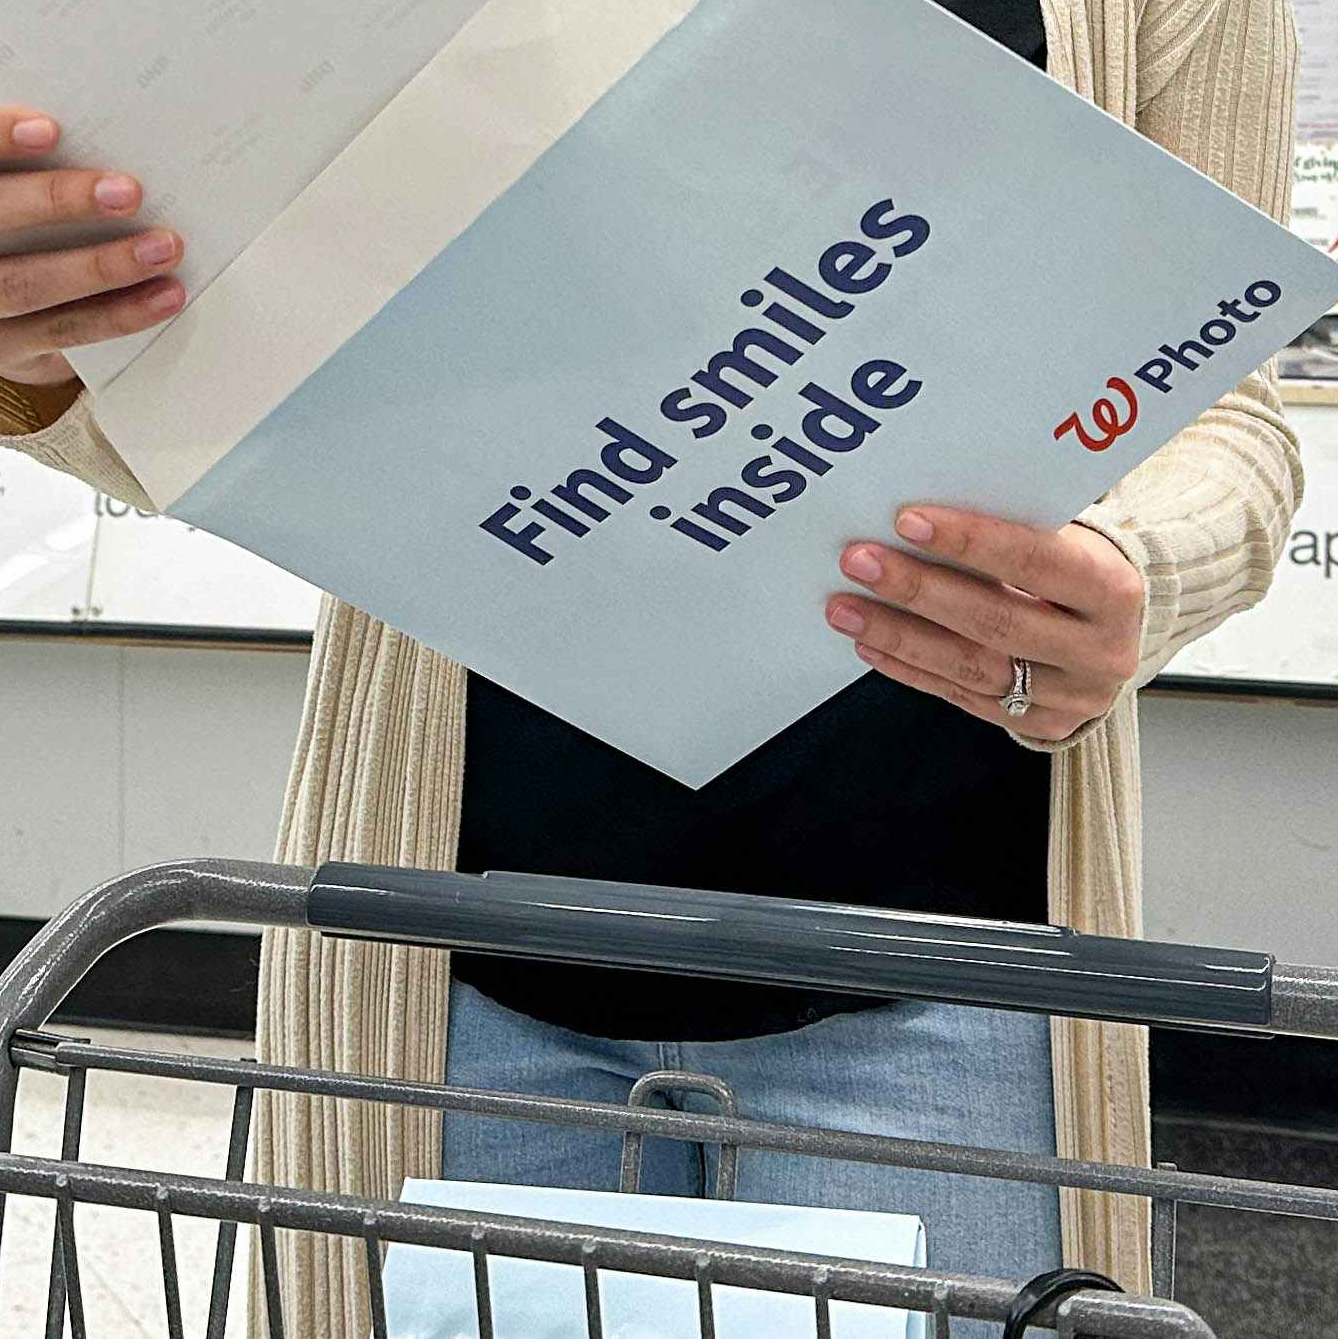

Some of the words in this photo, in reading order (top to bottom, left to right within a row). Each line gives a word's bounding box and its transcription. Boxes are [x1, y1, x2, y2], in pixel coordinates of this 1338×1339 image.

[478, 417, 677, 567] Find
[660, 196, 931, 439] smiles
[1134, 276, 1283, 393] Photo
[650, 358, 924, 553] inside
